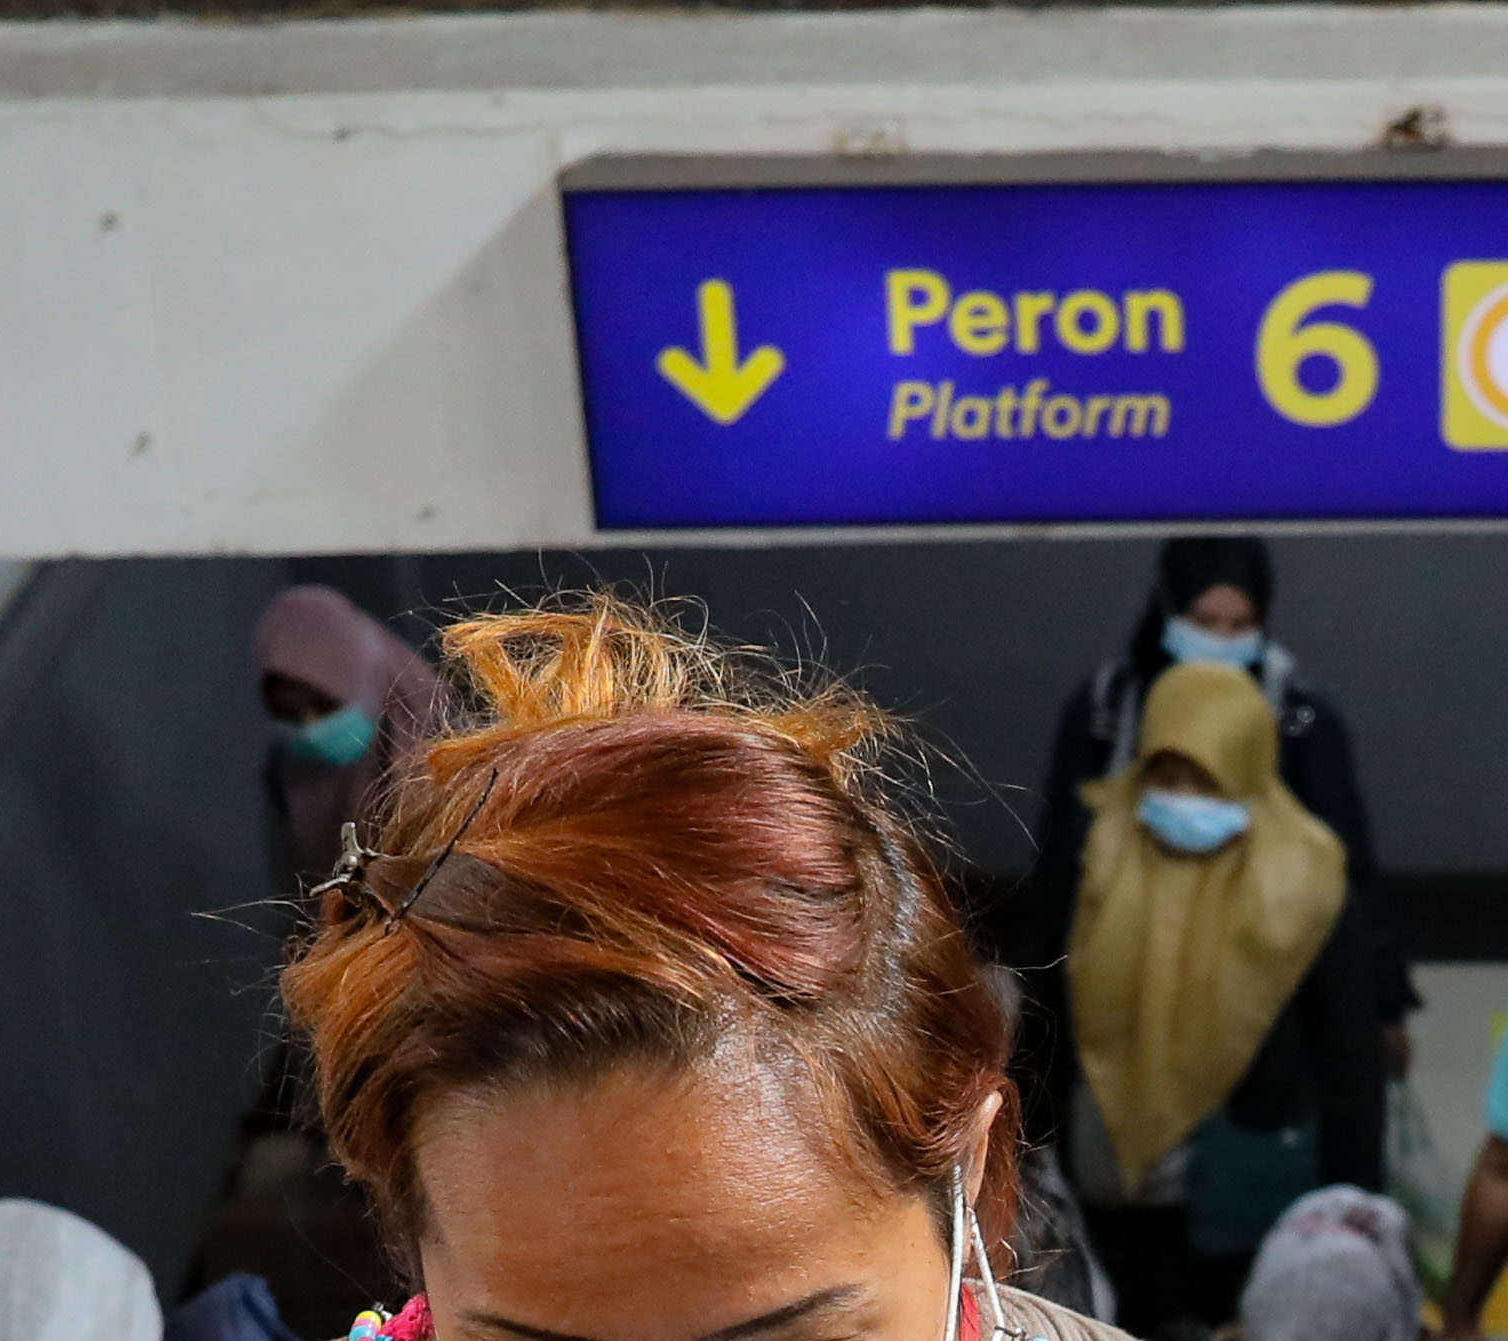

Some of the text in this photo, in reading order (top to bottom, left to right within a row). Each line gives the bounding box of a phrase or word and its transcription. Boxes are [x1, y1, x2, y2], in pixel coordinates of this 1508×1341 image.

[883, 268, 1186, 356] Peron
[1254, 270, 1381, 430] 6
[887, 380, 1172, 442] Platform
